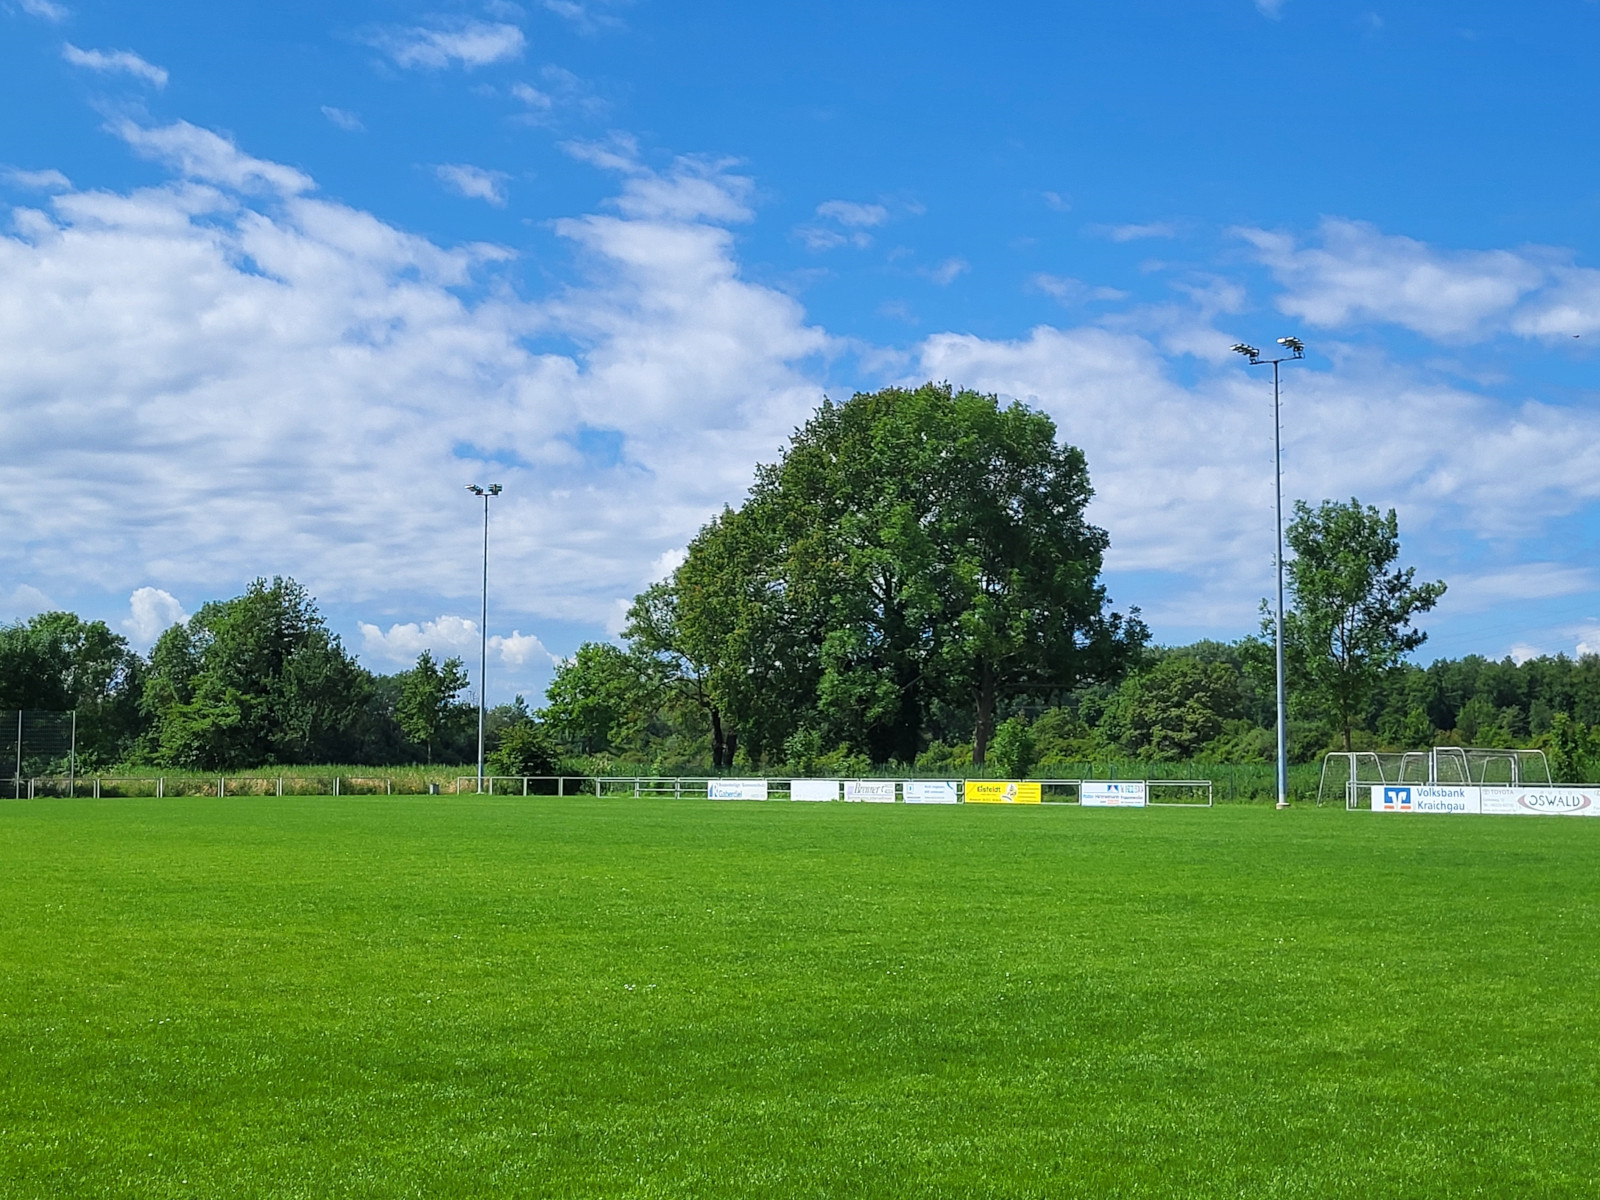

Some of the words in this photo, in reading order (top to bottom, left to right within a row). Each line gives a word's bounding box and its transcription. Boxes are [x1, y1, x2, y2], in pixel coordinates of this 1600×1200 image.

[1416, 787, 1465, 797] Volksbank
[1529, 794, 1580, 807] OSWALD
[1417, 801, 1465, 813] Kraichgau
